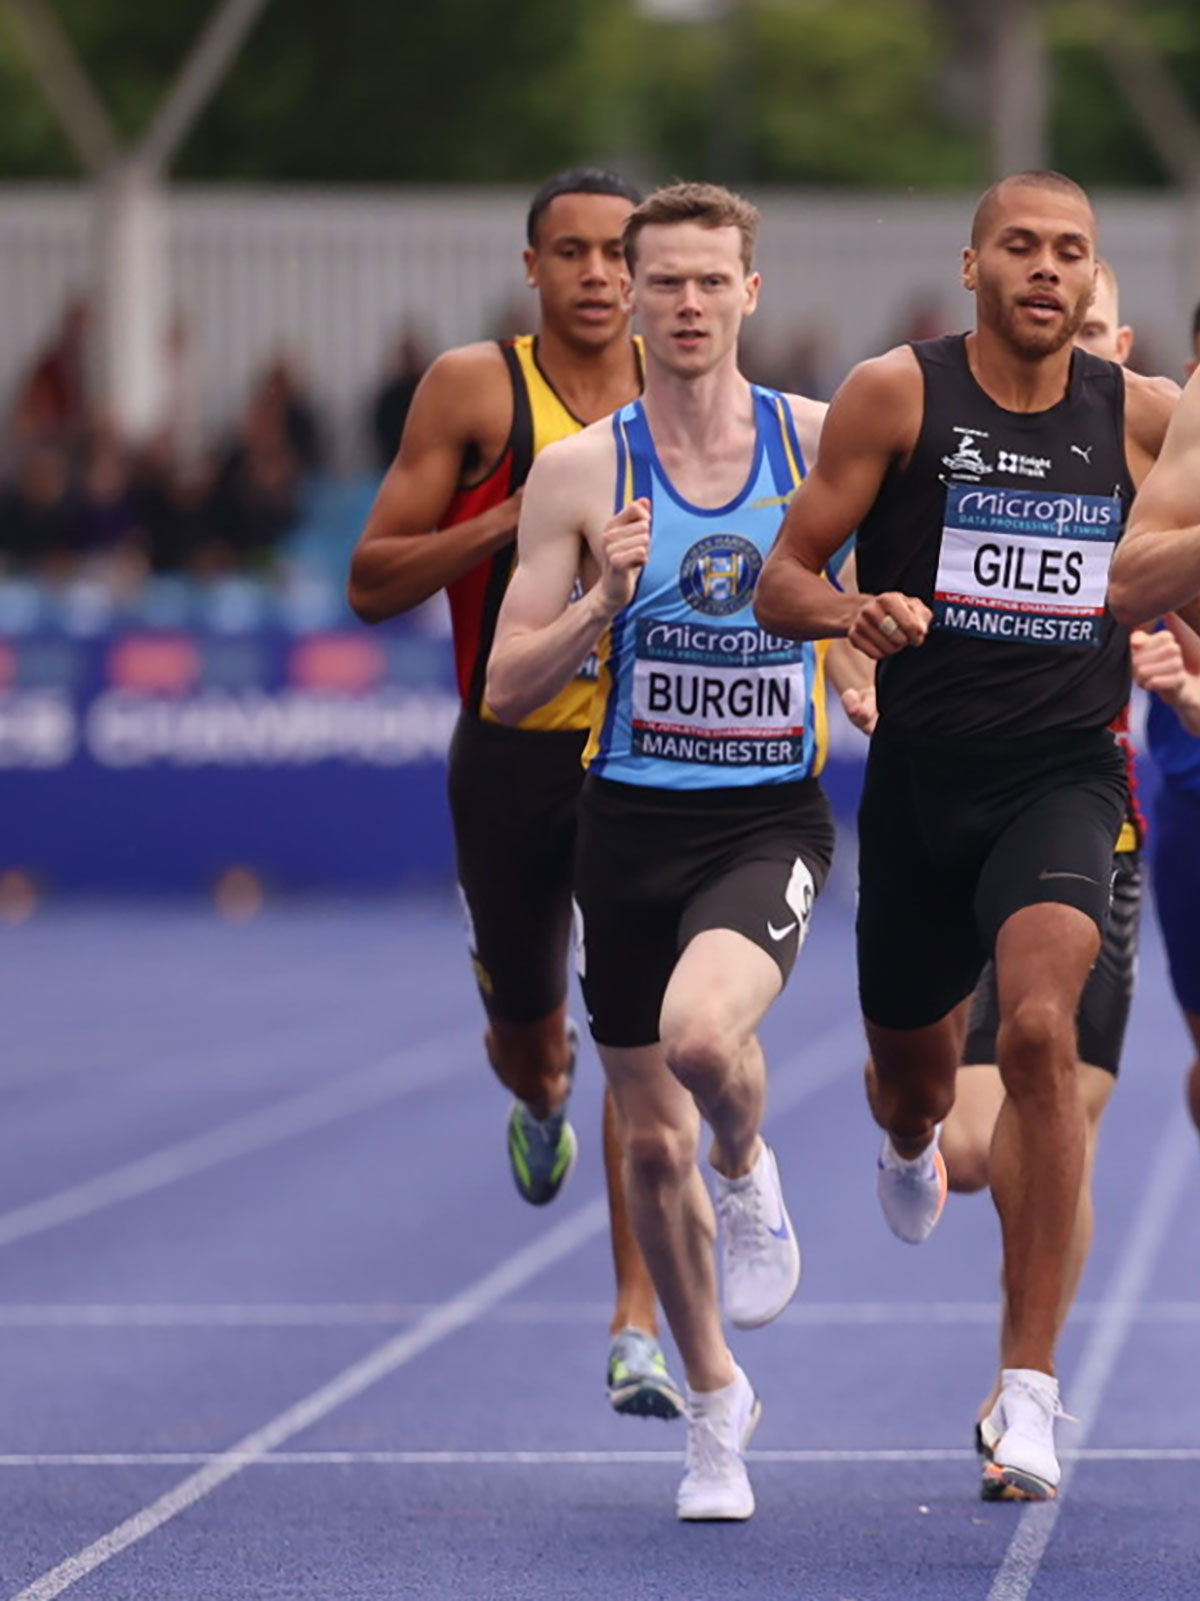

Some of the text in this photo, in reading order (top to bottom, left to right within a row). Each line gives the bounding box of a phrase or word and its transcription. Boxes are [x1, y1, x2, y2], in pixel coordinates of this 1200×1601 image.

[958, 491, 1111, 536] Microplus
[973, 543, 1083, 595] GILES
[944, 606, 1093, 641] MANCHESTER
[648, 671, 791, 719] BURGIN
[642, 733, 793, 762] MANCHESTER
